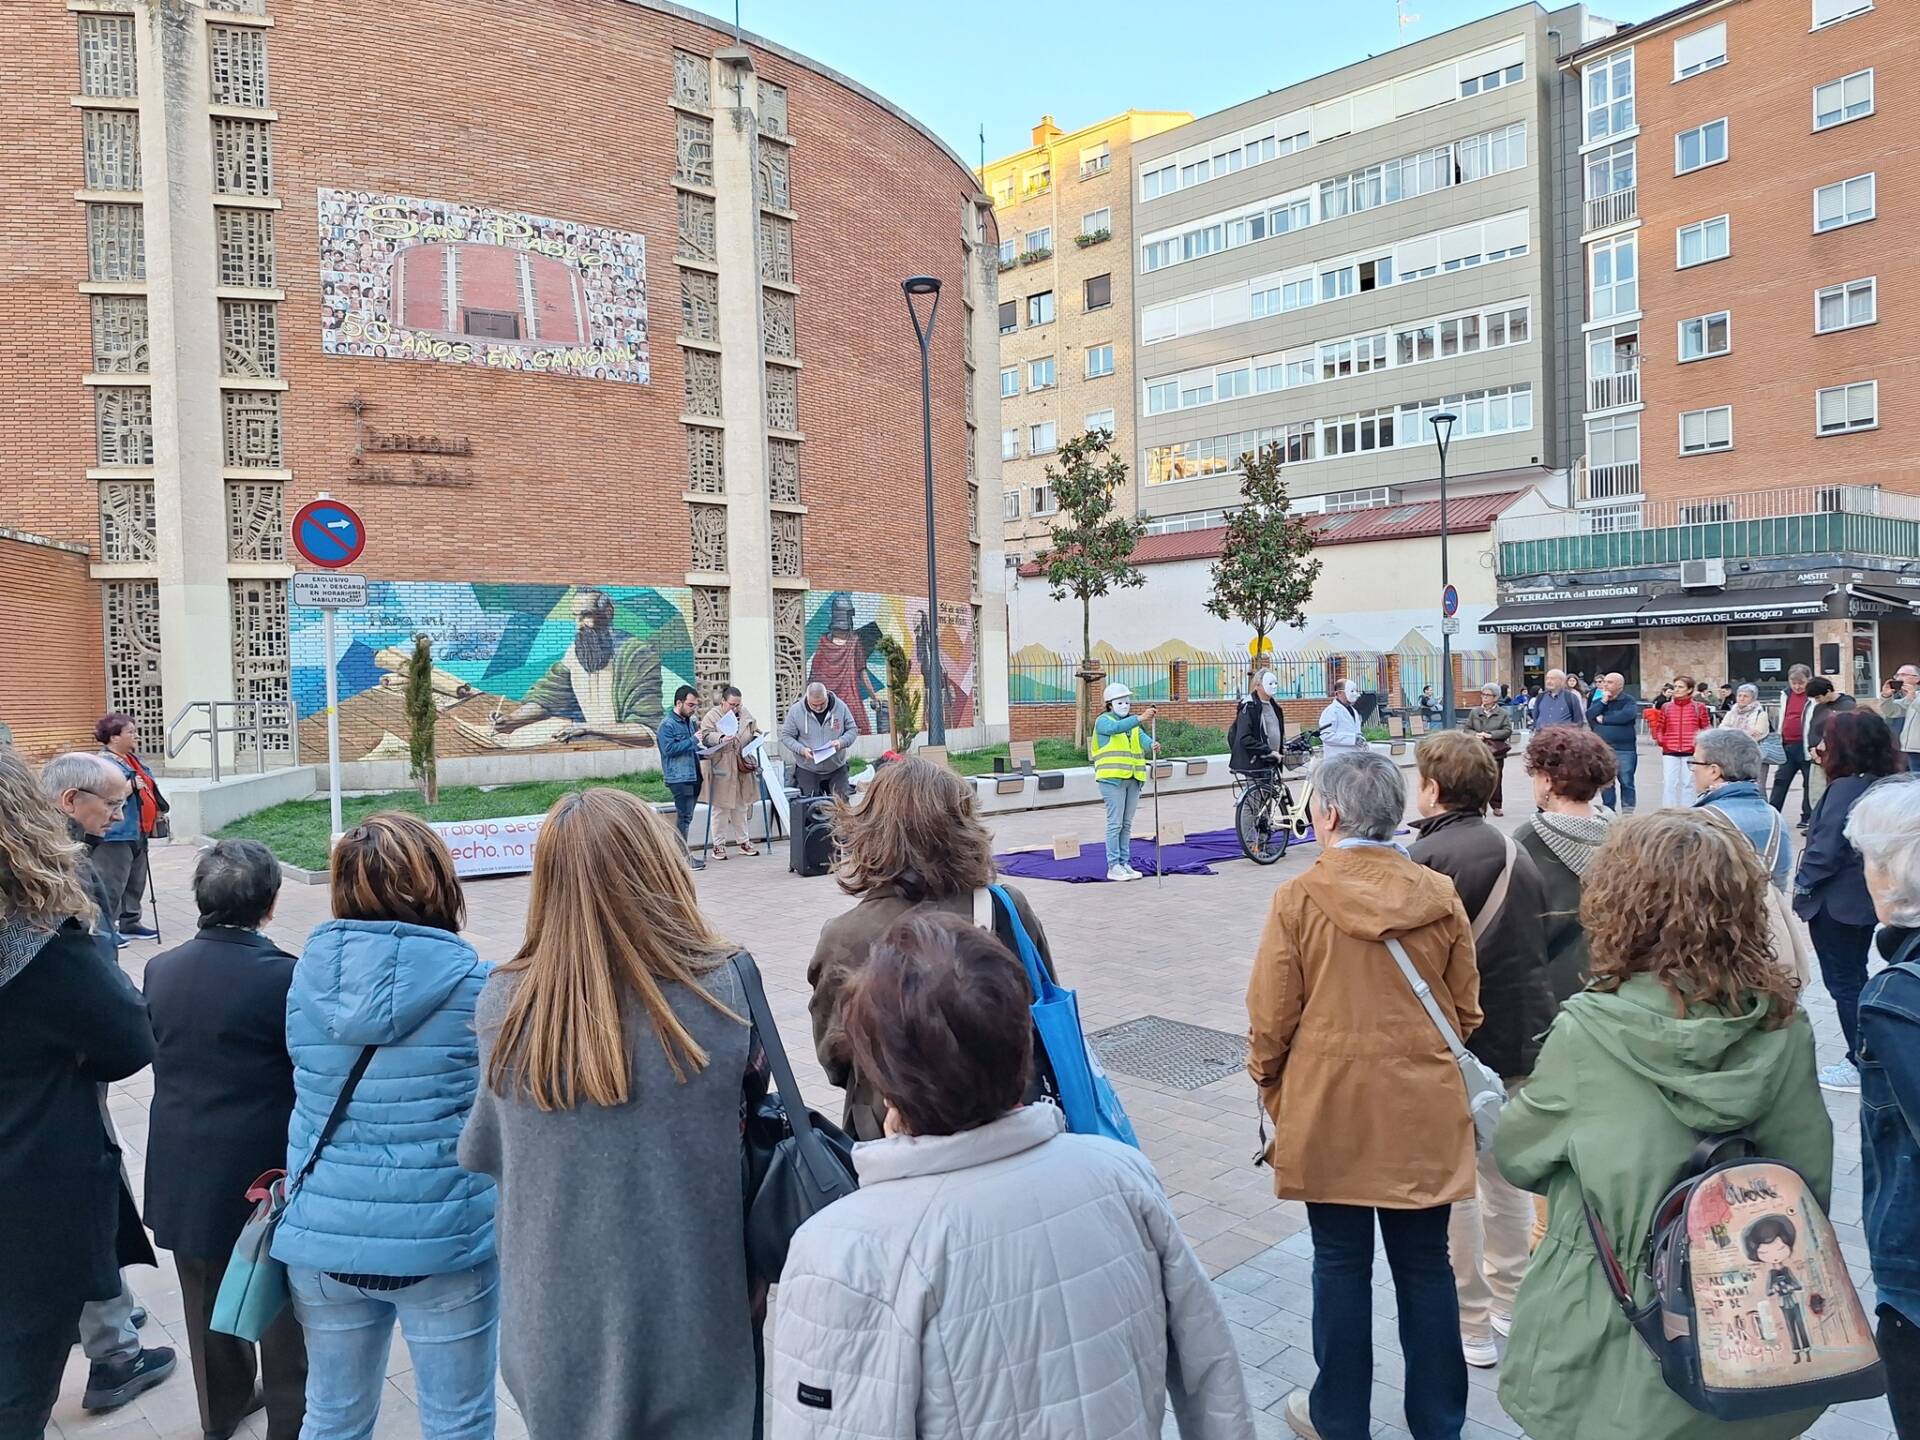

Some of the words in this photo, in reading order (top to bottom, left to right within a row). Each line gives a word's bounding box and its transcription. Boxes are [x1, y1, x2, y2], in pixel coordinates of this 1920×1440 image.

[342, 313, 390, 344] 50
[400, 332, 472, 363] AÑOS
[487, 350, 519, 367] EN
[532, 345, 637, 369] GAMONAL
[1515, 591, 1572, 602] TERRACITA
[1659, 614, 1712, 625] TERRACITA
[1713, 612, 1732, 621] DEL
[1734, 609, 1783, 620] konogan
[1496, 623, 1543, 633] TERRACITA
[1543, 622, 1560, 630] DEL
[1561, 620, 1604, 629] konogan
[504, 821, 544, 833] dece
[450, 841, 500, 860] echo,
[503, 844, 525, 857] no
[1725, 1286, 1749, 1297] WANT
[1730, 1298, 1741, 1308] BE
